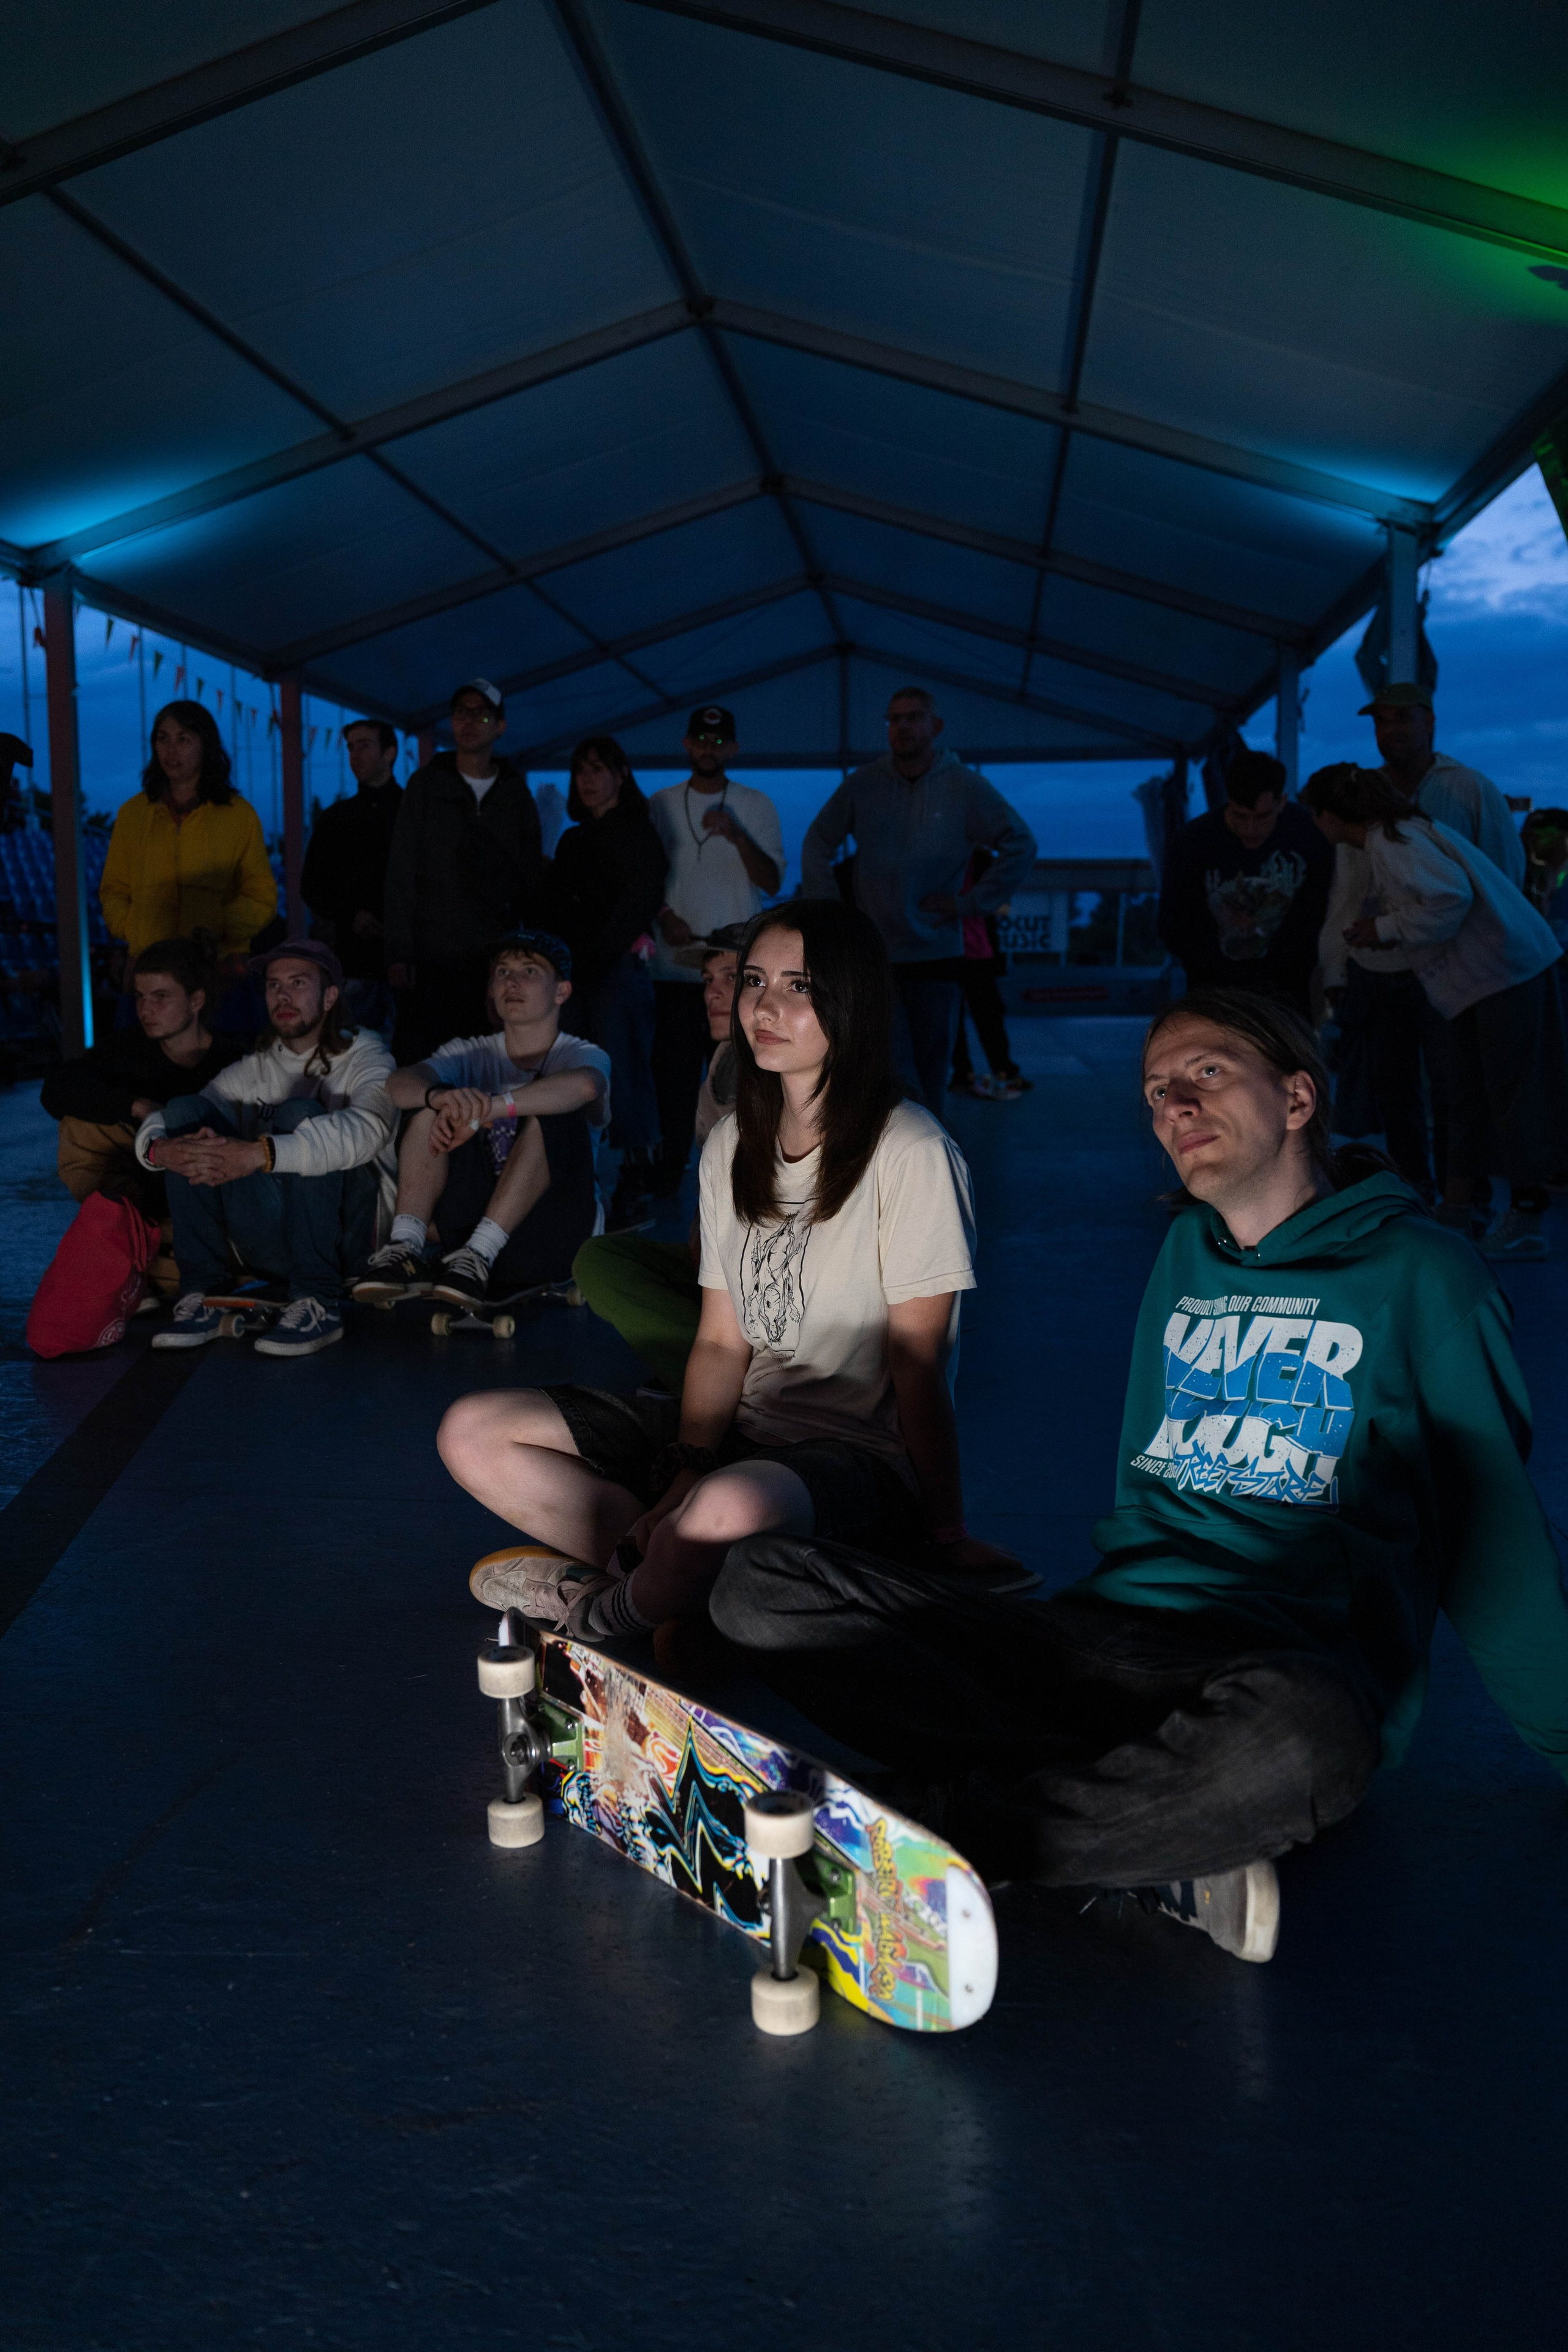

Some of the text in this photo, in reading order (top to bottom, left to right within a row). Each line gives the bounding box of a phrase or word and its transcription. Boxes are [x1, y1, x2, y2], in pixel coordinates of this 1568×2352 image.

[1175, 1295, 1213, 1316] PROUDLY
[1227, 1295, 1253, 1312] OUR
[1251, 1296, 1321, 1316] COMMUNITY
[1130, 1454, 1167, 1476] SINCE
